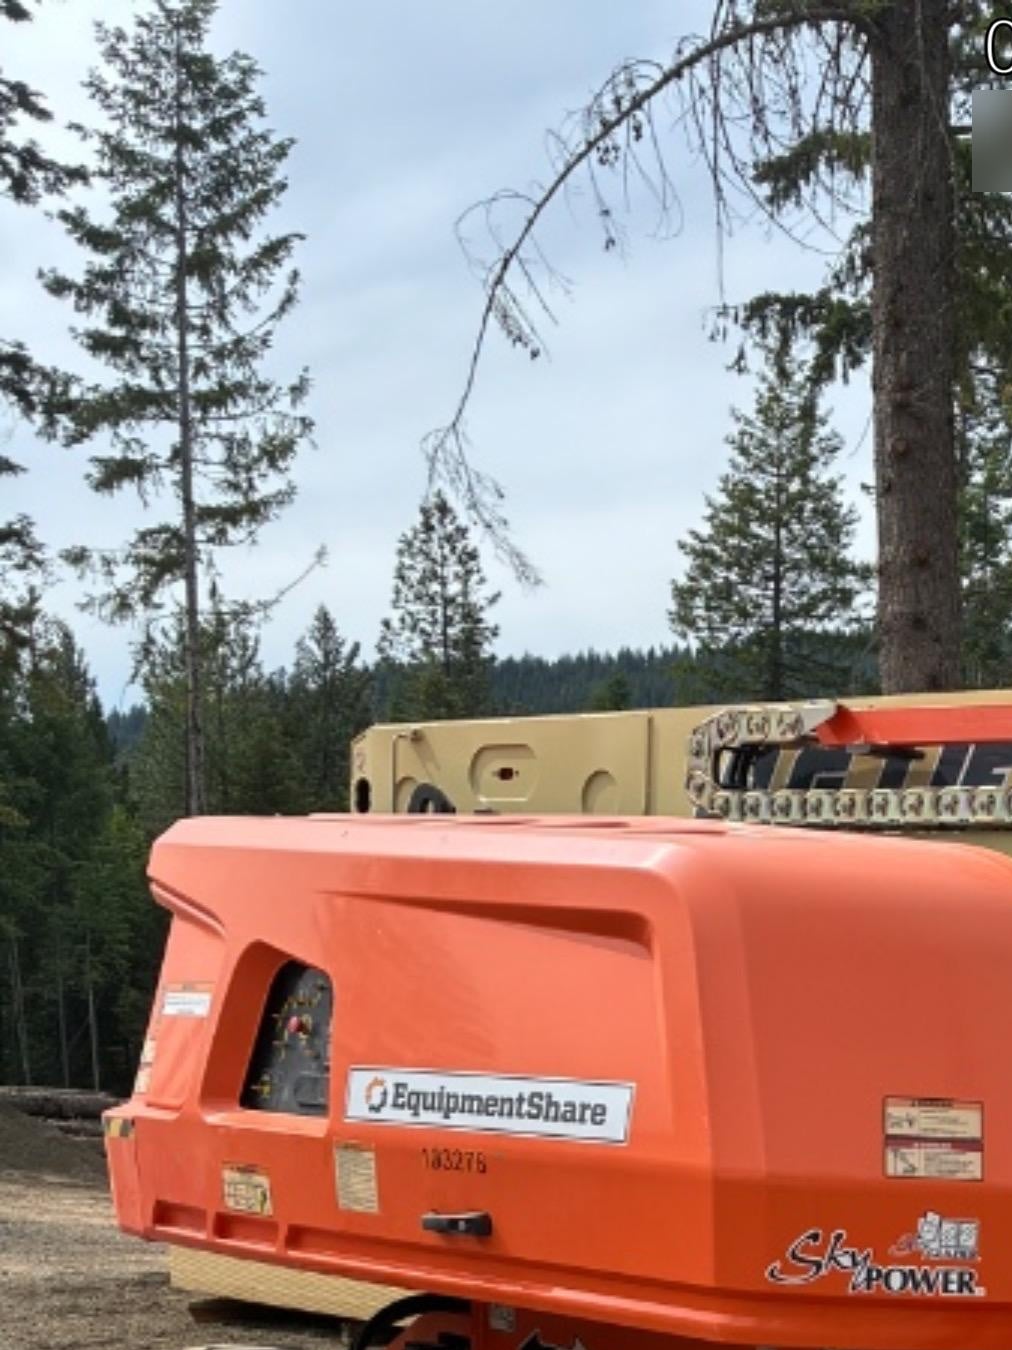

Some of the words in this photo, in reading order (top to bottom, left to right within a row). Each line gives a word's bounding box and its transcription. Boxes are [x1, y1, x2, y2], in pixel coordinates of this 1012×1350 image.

[390, 1081, 608, 1127] EquipmentShare
[765, 1229, 872, 1295] Sky
[864, 1266, 976, 1295] POWER
